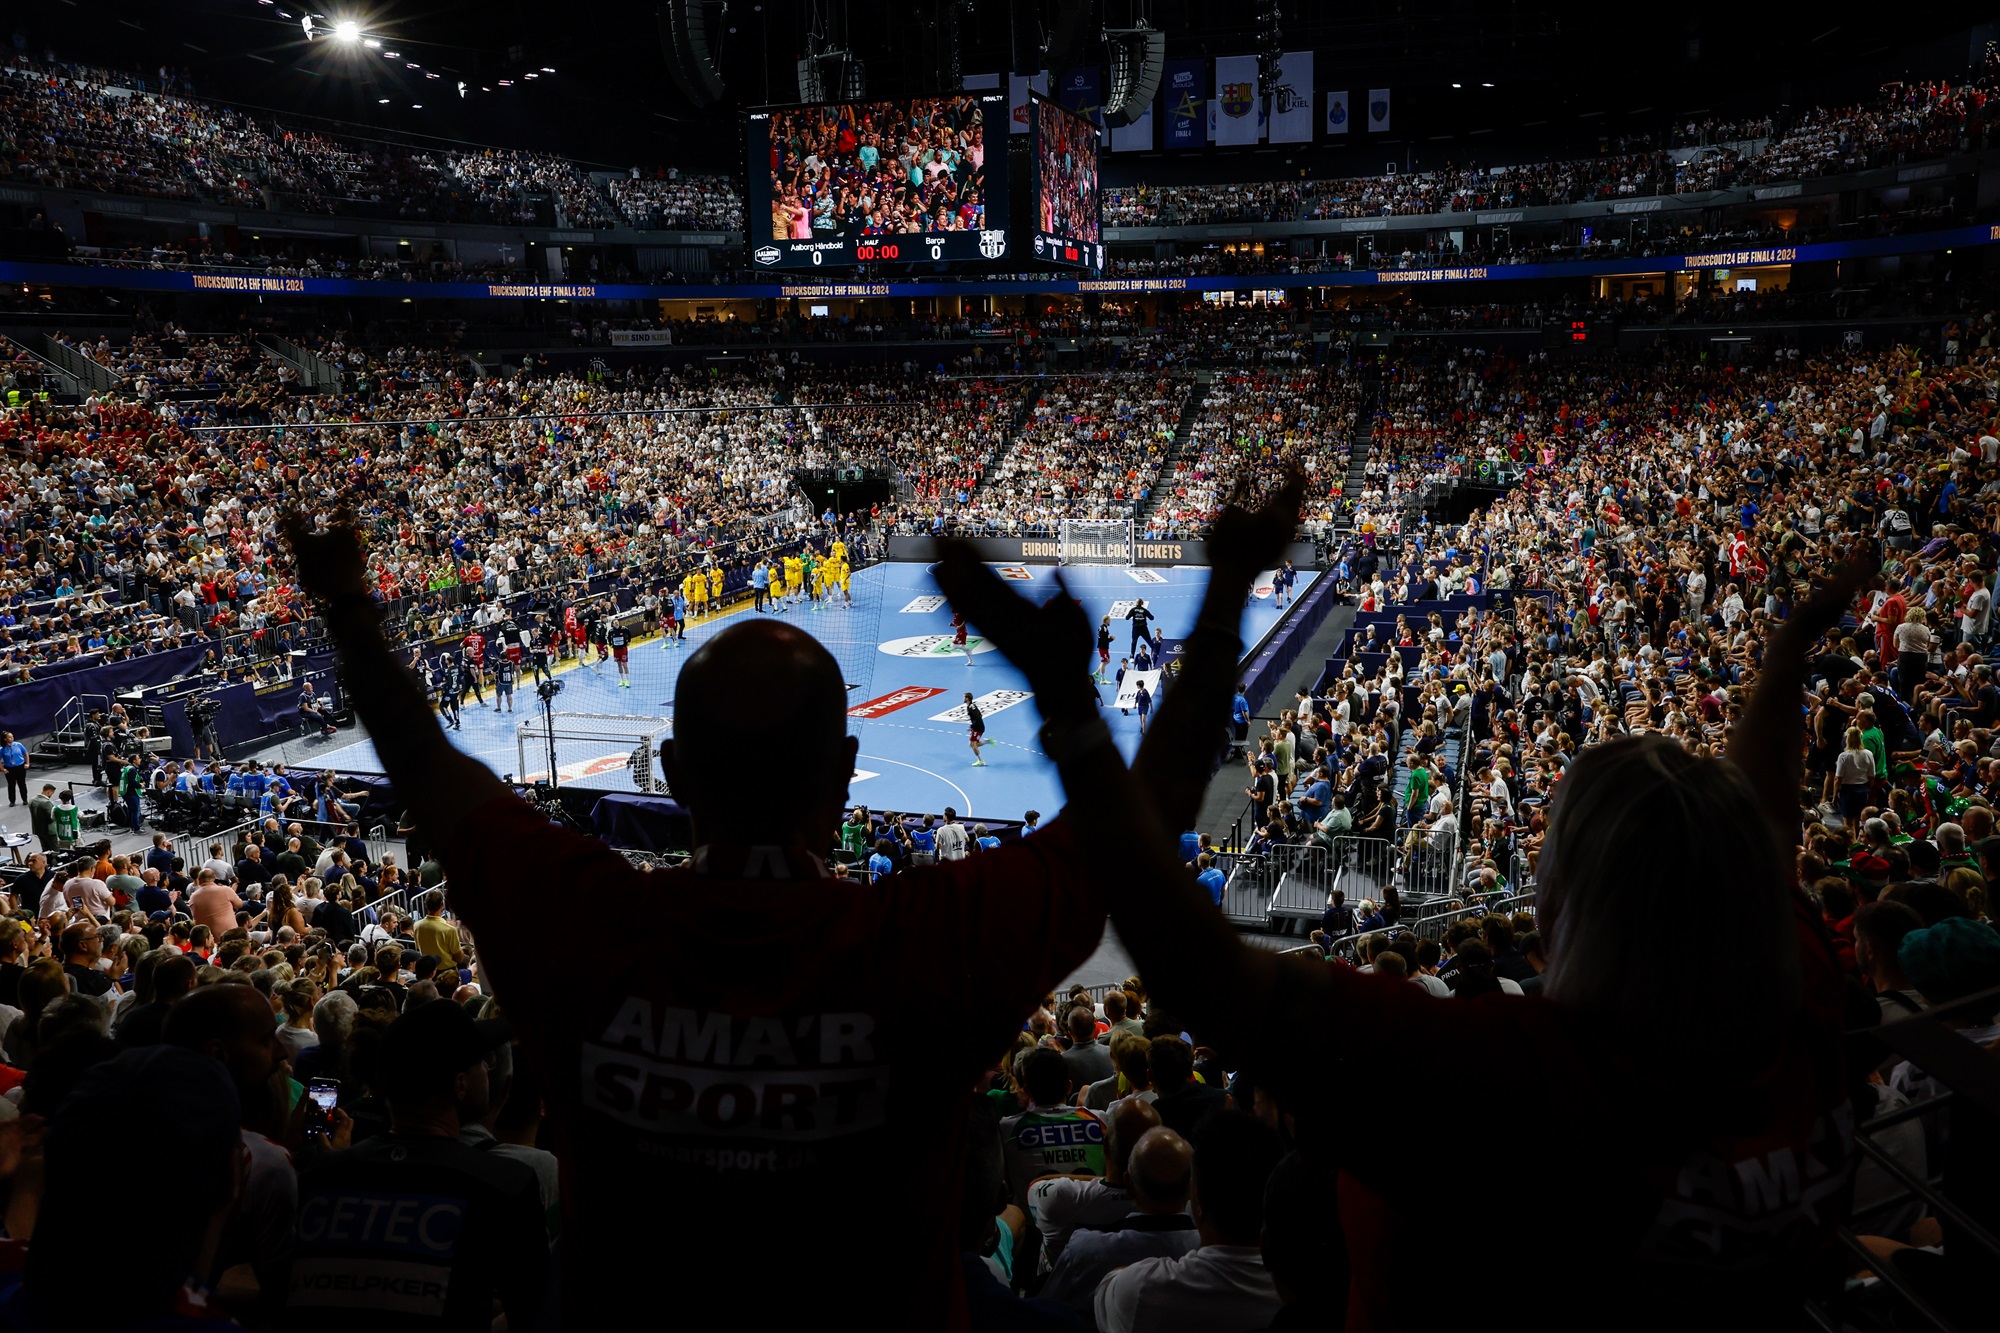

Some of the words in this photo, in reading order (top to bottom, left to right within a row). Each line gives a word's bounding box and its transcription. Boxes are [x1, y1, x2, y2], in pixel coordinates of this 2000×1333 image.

[790, 243, 814, 252] Aalborg
[926, 237, 945, 245] Barça
[813, 250, 822, 265] 0
[857, 245, 899, 260] 00:00
[931, 245, 941, 260] 0
[1684, 252, 1736, 268] TRUCKSCOUT24
[1736, 251, 1749, 264] EHF
[1750, 249, 1775, 263] FINAL4
[1776, 248, 1796, 261] 2024
[192, 274, 248, 290] TRUCKSCOUT24
[249, 277, 261, 290] EHF
[262, 278, 284, 291] FINAL4
[286, 279, 304, 291] 2024
[1377, 270, 1430, 282] TRUCKSCOUT24
[1431, 270, 1443, 280] EHF
[1444, 269, 1467, 279] FINAL4
[1469, 268, 1487, 279] 2024
[488, 285, 538, 297] TRUCKSCOUT24
[539, 285, 551, 297] EHF
[553, 285, 576, 297] FINAL4
[577, 286, 595, 297] 2024
[781, 285, 833, 296] TRUCKSCOUT24
[834, 285, 847, 295] EHF
[847, 285, 870, 295] FINAL4
[871, 285, 889, 295] 2024
[1078, 280, 1130, 291] TRUCKSCOUT24
[1131, 280, 1143, 290] EHF
[1144, 280, 1167, 290] FINAL4
[1168, 279, 1186, 289] 2024
[614, 333, 630, 342] WIR
[631, 333, 650, 342] SIND
[651, 332, 670, 342] KIEL
[600, 995, 876, 1067] AMA'R
[594, 1062, 876, 1130] SPORT
[1019, 1122, 1103, 1147] GETEC
[1043, 1149, 1087, 1165] WEBER
[299, 1196, 463, 1251] GETEC
